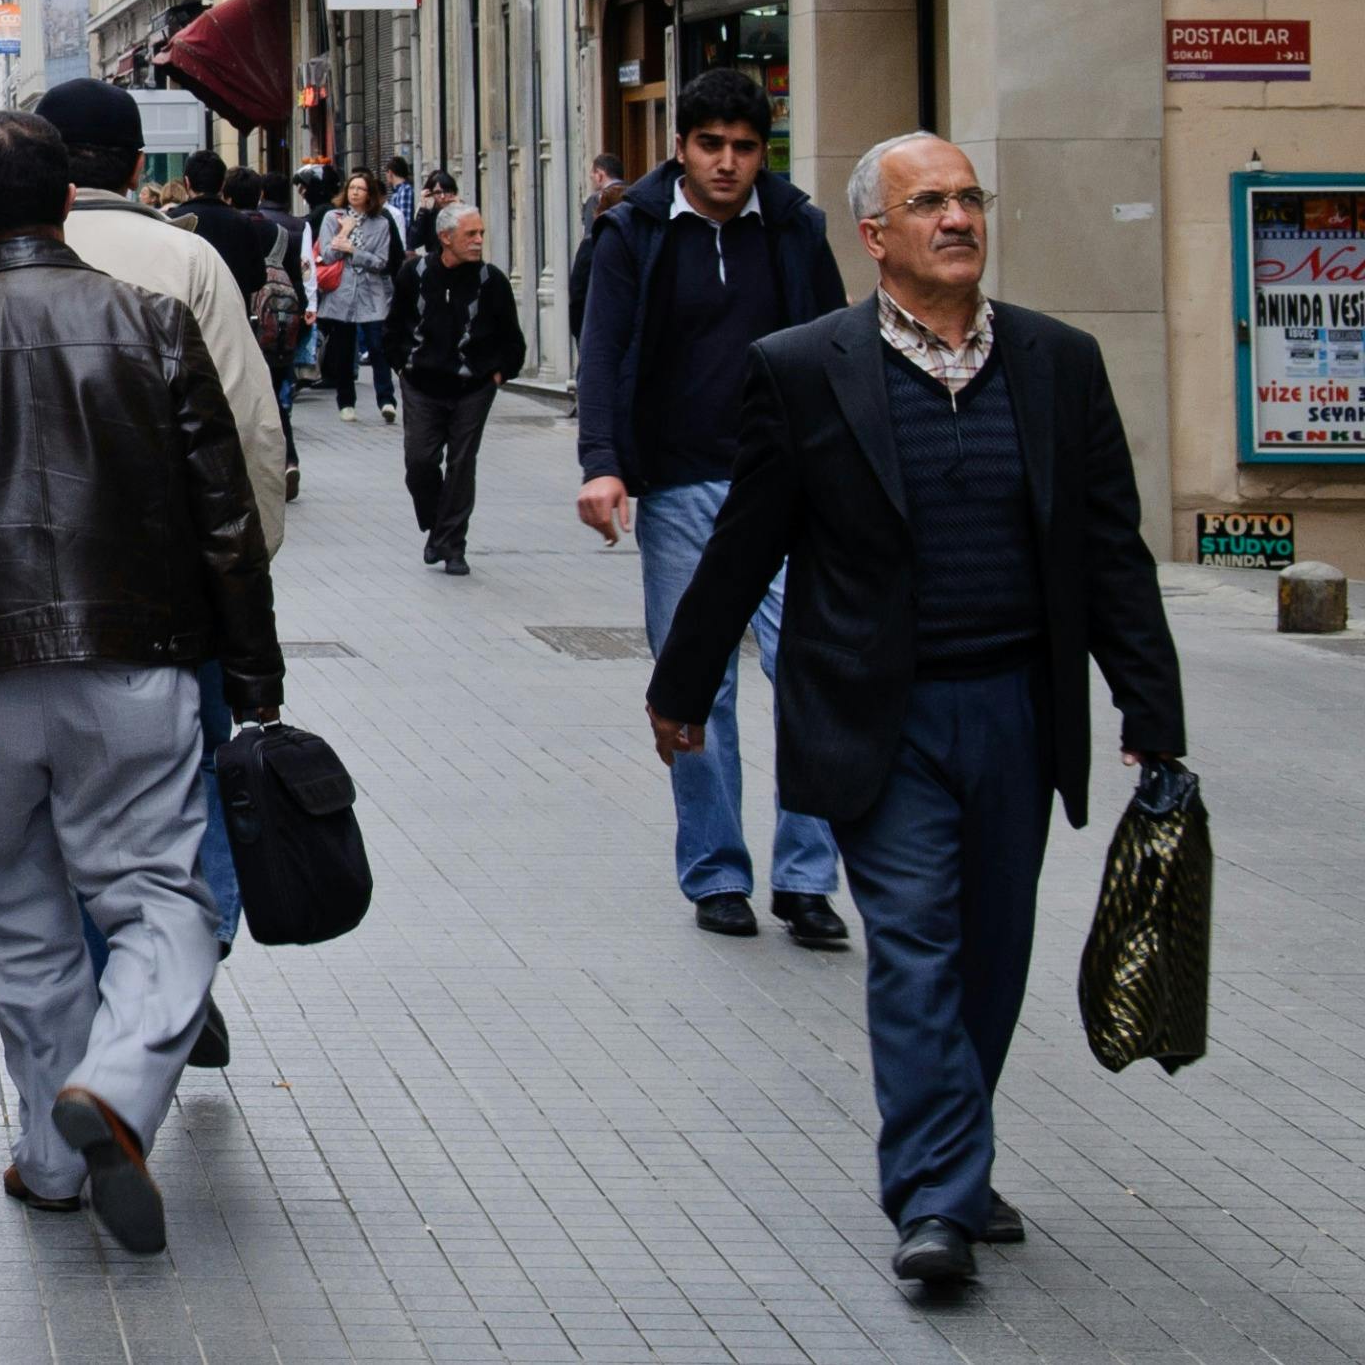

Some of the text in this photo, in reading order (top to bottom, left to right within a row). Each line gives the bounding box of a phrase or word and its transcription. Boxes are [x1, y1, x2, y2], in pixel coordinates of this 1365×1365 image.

[1172, 28, 1290, 45] POSTACILAR
[1173, 50, 1213, 60] SOKAĞI
[1257, 379, 1302, 402] VİZE
[1309, 379, 1349, 406] İÇİN
[1204, 514, 1292, 536] FOTO
[1202, 554, 1267, 568] ANINDA
